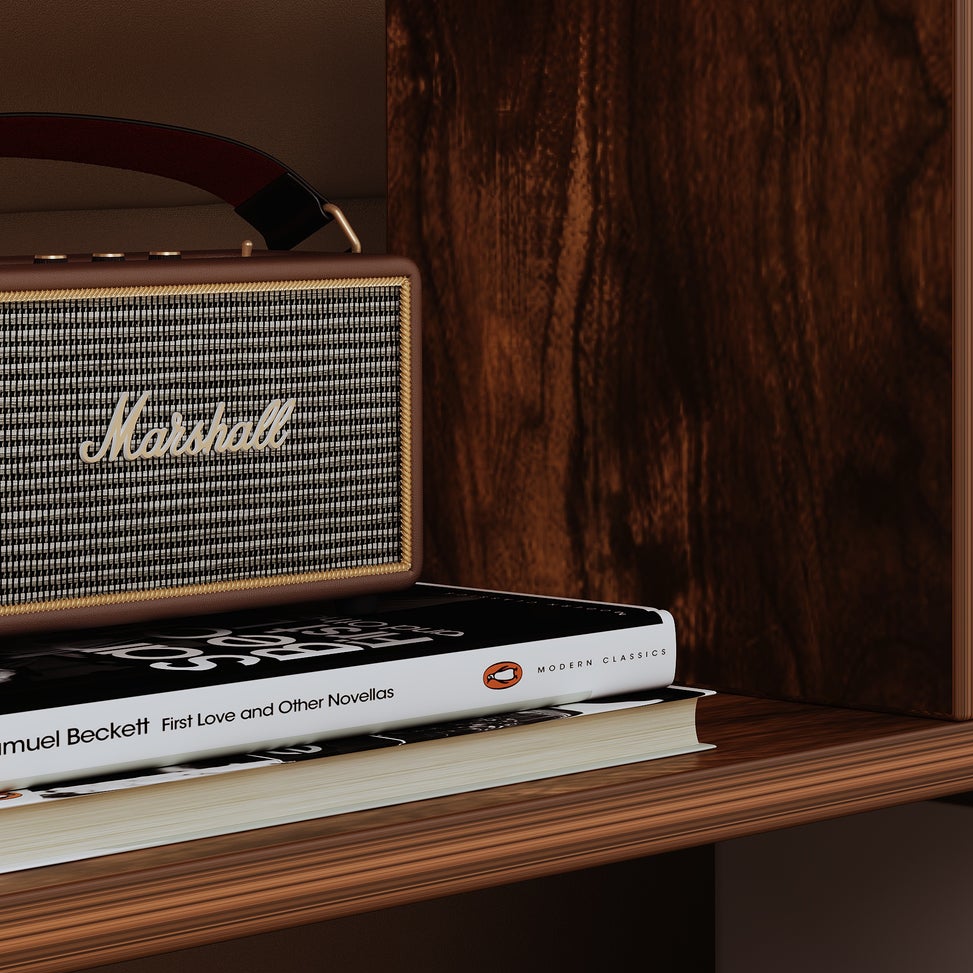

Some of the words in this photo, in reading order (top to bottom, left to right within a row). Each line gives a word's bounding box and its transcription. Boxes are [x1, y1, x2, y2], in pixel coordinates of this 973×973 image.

[79, 390, 296, 464] Marshall
[537, 659, 593, 674] MODERN
[602, 648, 668, 664] CLASSICS
[0, 730, 60, 756] muel
[67, 717, 150, 746] Beckett
[162, 714, 193, 732] First
[197, 709, 236, 727] Love
[240, 703, 274, 720] and
[278, 697, 325, 714] Other
[328, 687, 395, 707] Novellas
